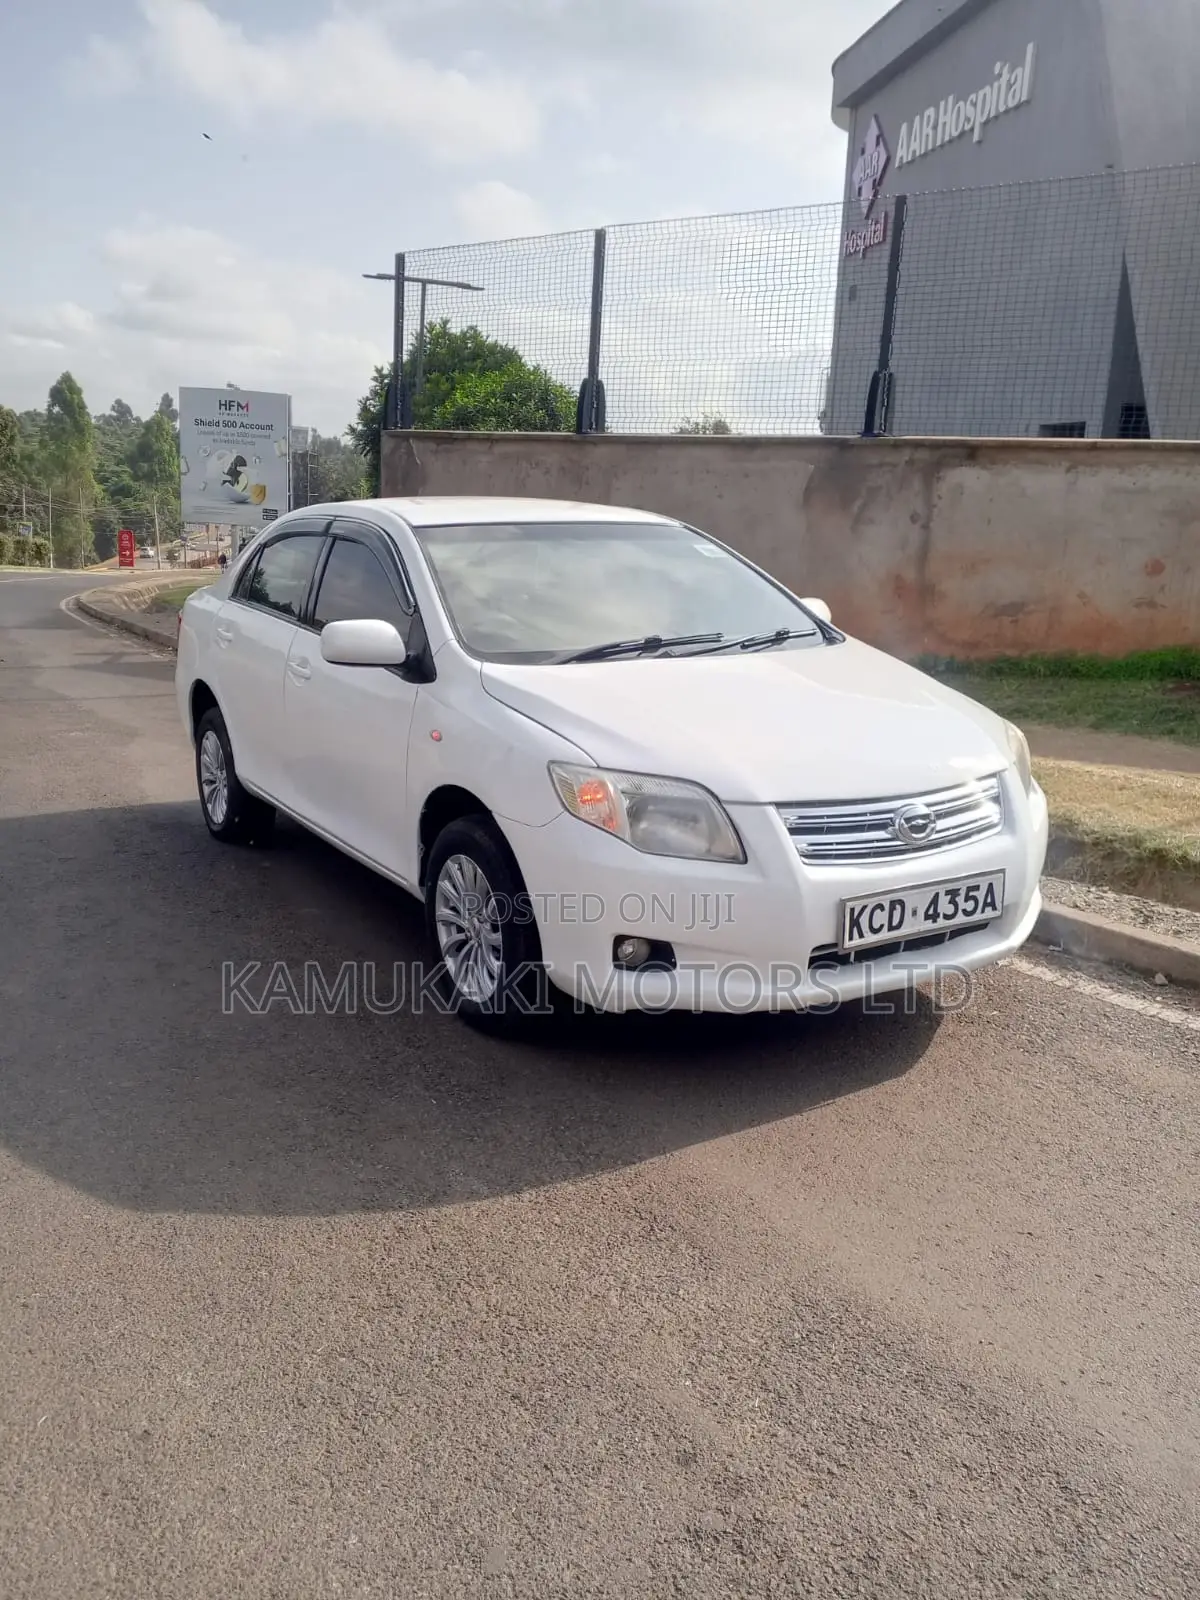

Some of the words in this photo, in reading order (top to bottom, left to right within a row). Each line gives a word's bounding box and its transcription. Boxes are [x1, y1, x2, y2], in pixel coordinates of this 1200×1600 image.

[843, 210, 886, 259] Hospital
[218, 399, 249, 413] HFM
[193, 418, 220, 428] Shield
[222, 419, 238, 429] 500
[238, 421, 274, 431] Account
[848, 898, 906, 942] KCD
[923, 882, 998, 924] 435A
